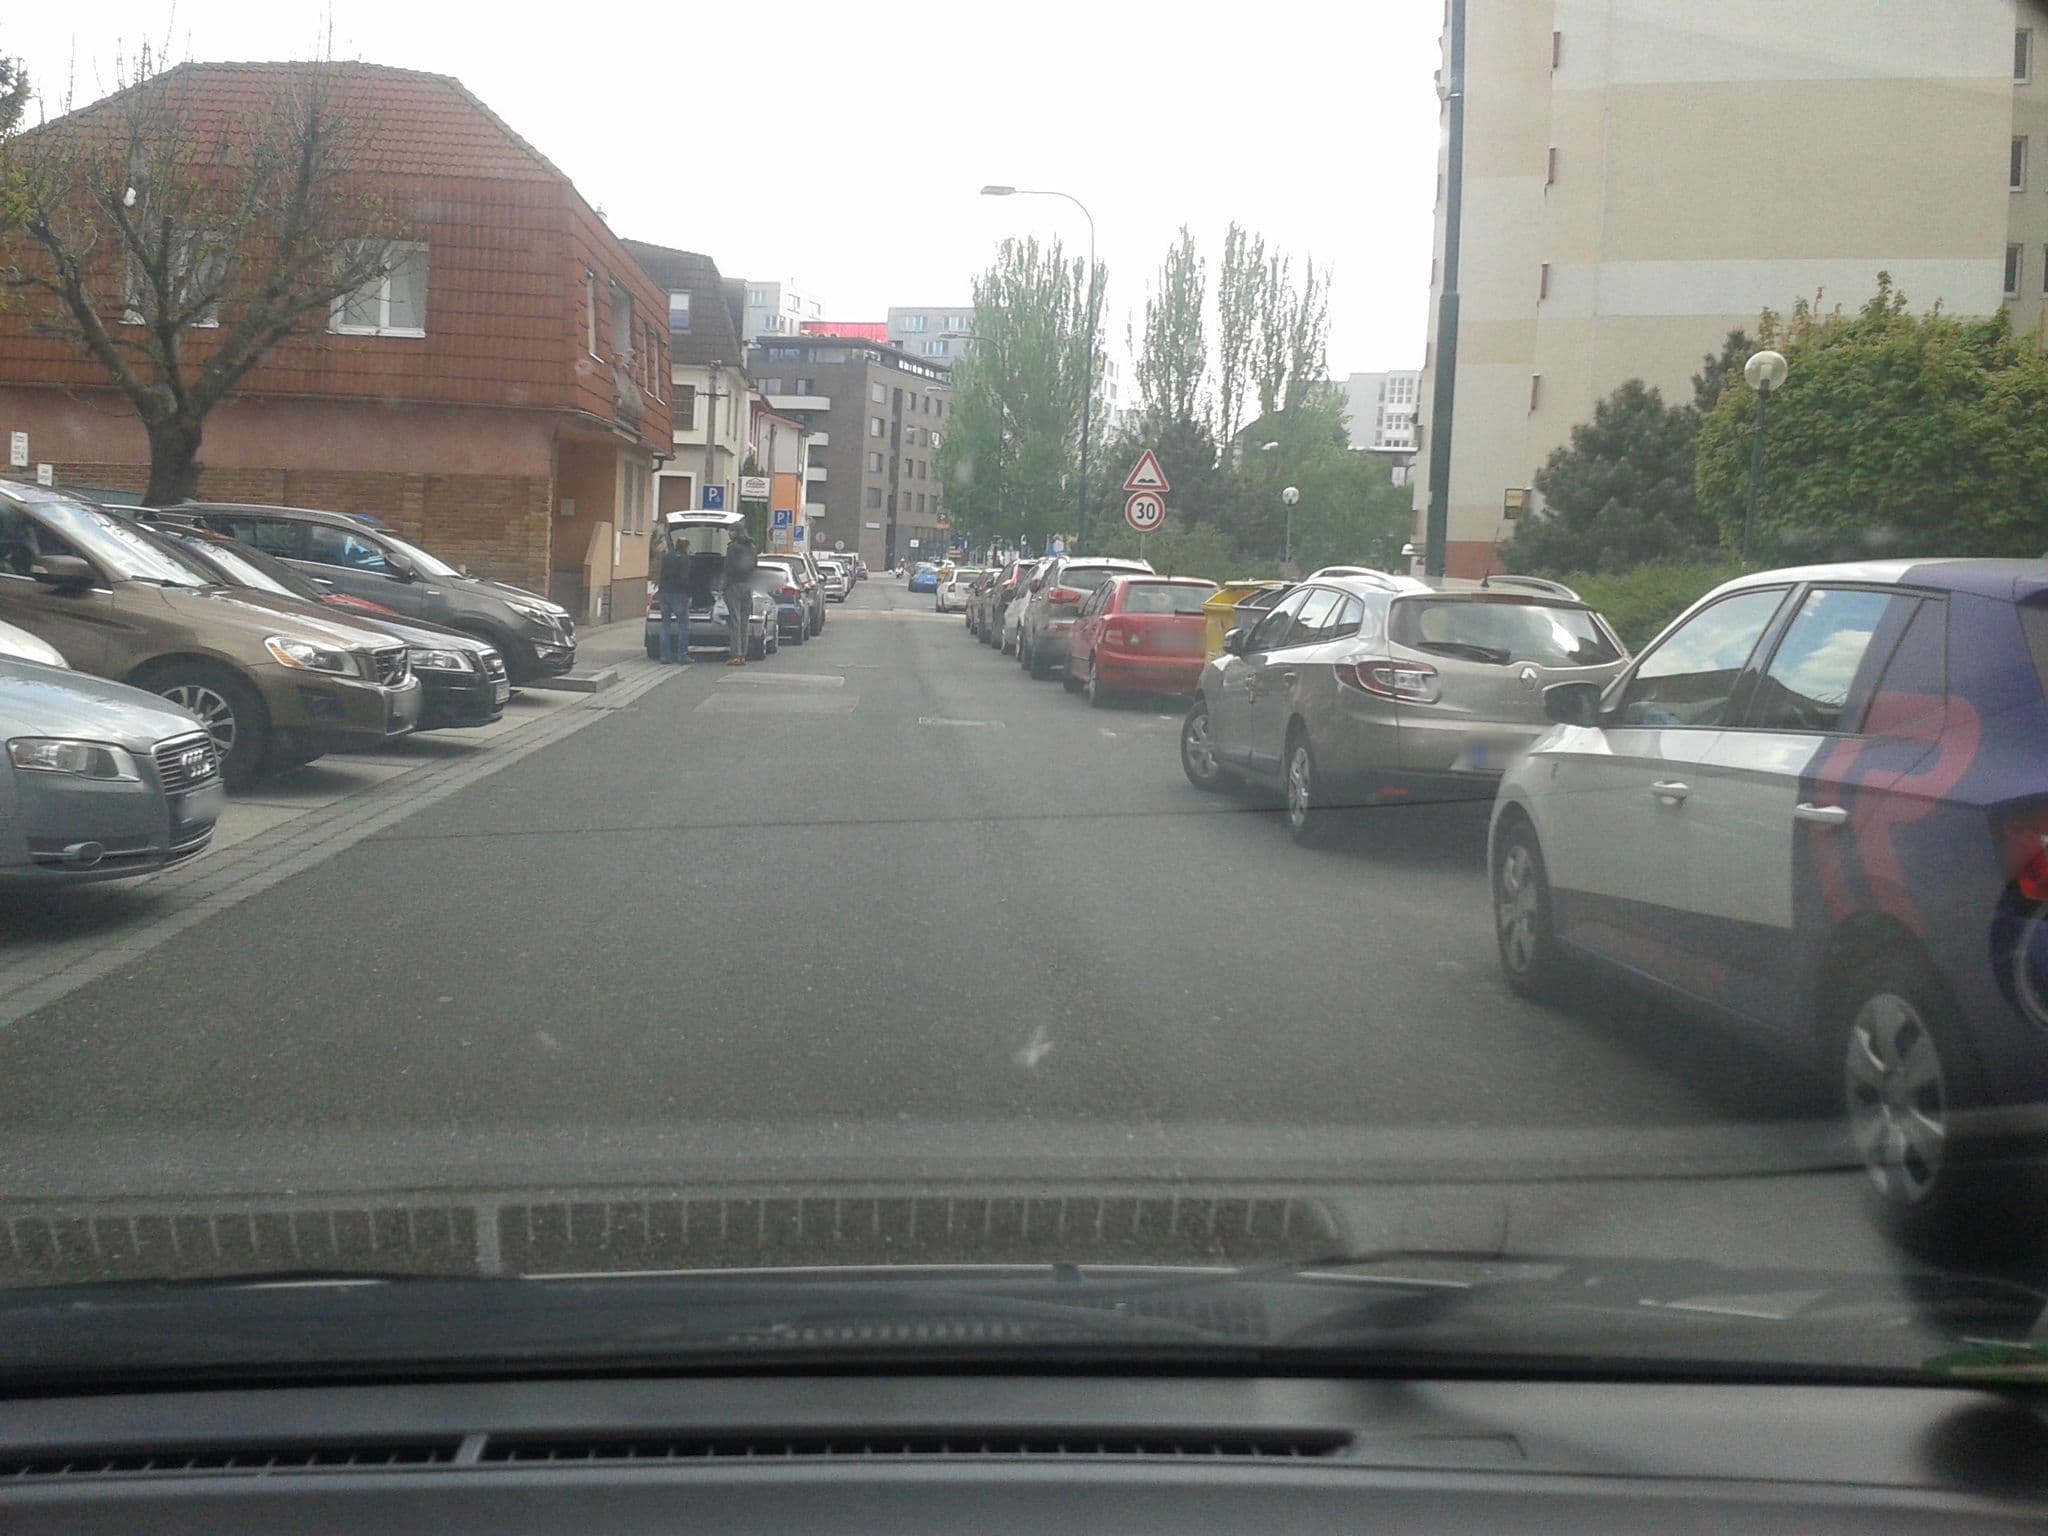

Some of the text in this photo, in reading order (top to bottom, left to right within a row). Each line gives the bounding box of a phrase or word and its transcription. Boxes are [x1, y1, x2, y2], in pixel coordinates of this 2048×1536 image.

[709, 488, 718, 502] P
[777, 512, 785, 523] P
[1136, 502, 1155, 519] 30
